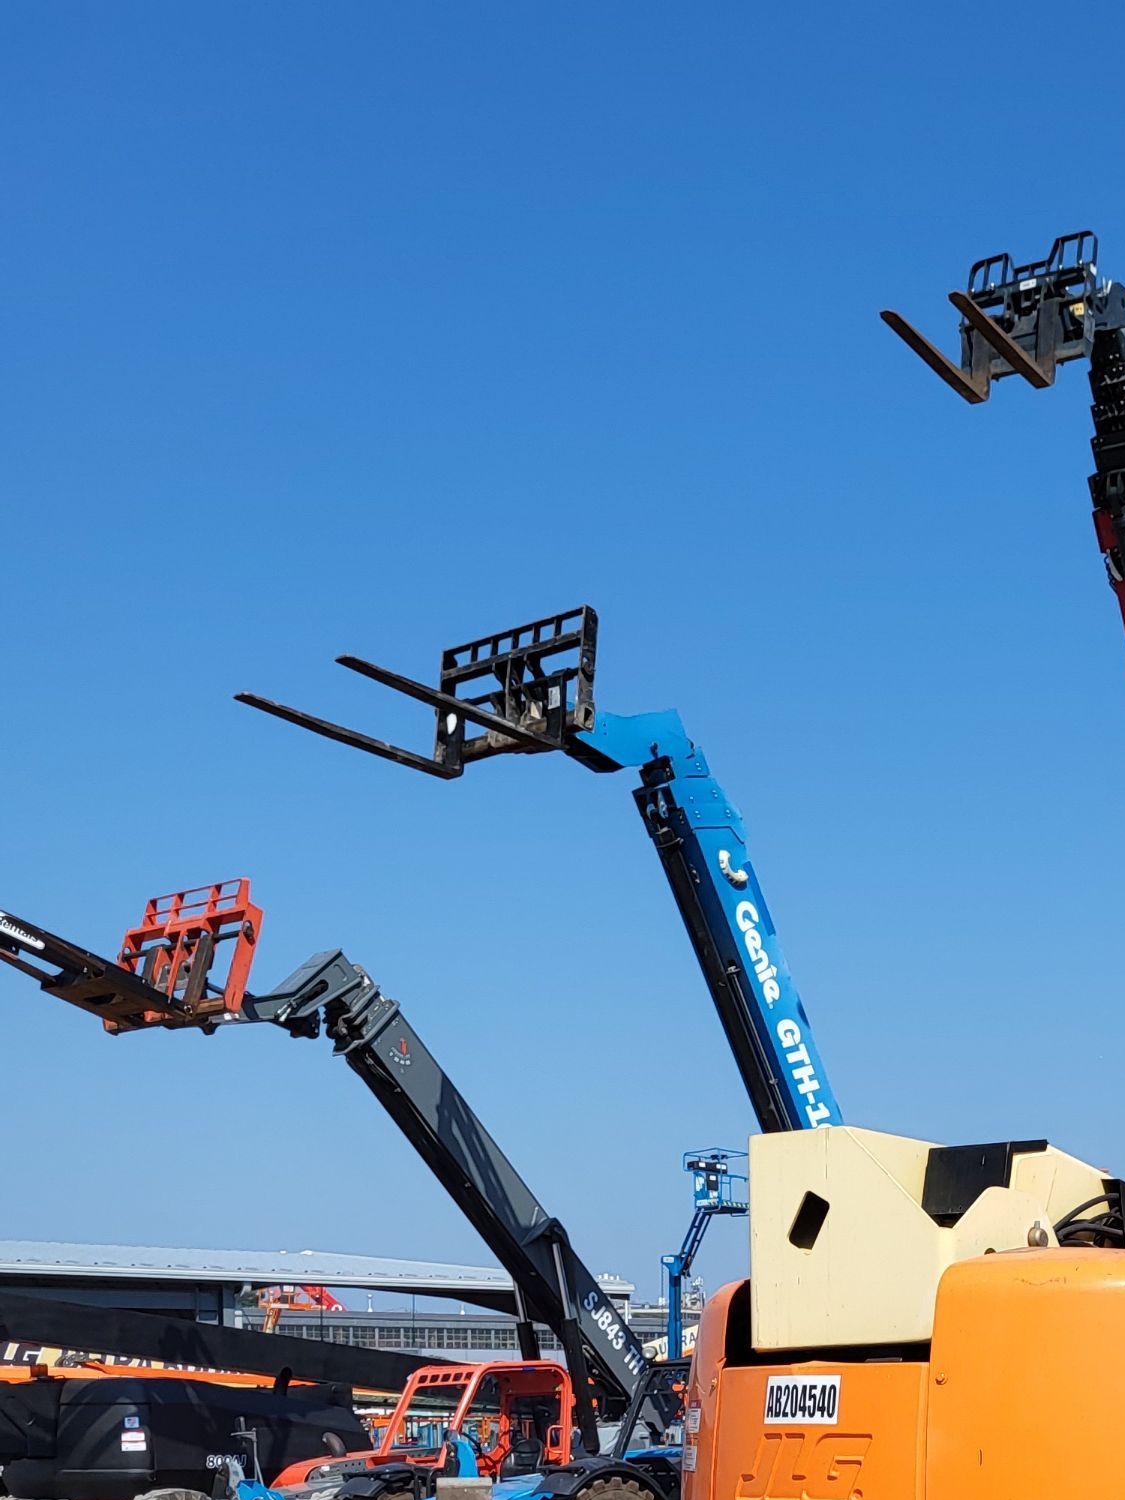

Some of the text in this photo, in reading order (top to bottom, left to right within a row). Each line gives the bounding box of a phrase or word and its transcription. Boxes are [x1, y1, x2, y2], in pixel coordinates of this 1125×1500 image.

[736, 900, 833, 1129] Genie GTH-1
[583, 1291, 645, 1375] SJ843 TH
[766, 1384, 837, 1418] AB204540
